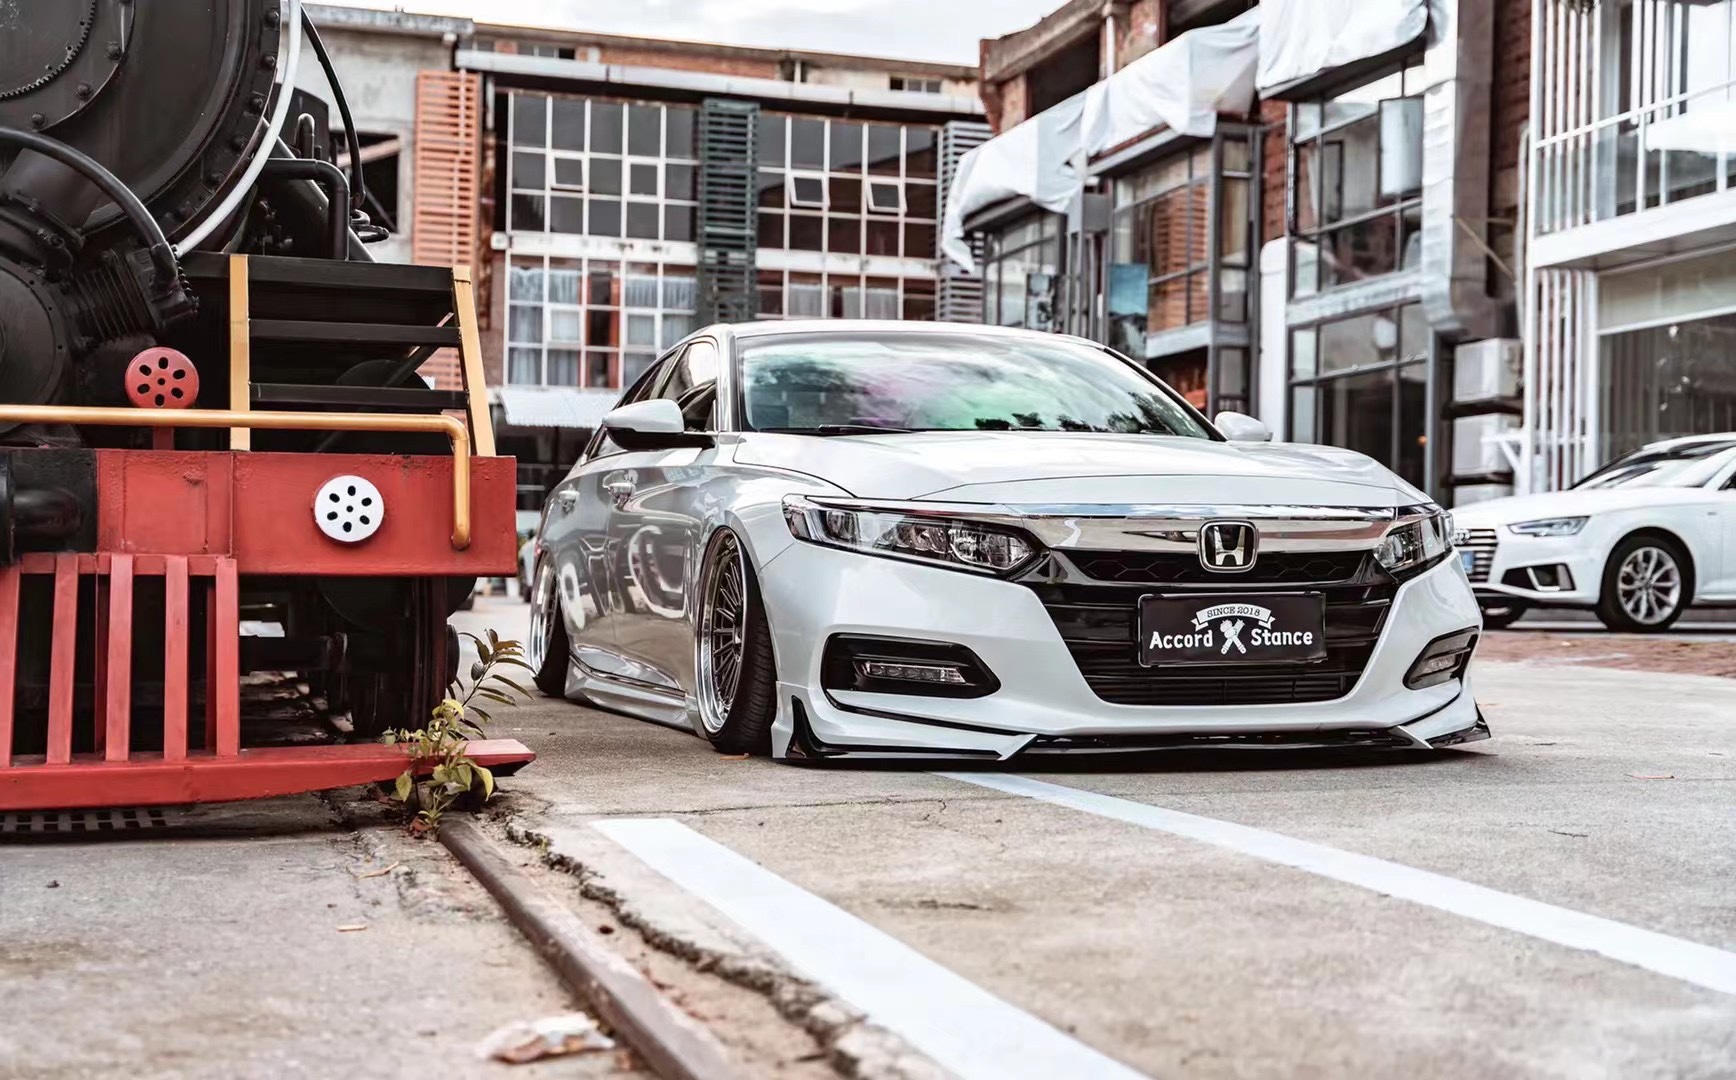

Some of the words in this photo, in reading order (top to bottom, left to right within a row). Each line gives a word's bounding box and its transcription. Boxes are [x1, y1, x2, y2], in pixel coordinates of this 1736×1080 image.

[1206, 606, 1236, 618] SINCE
[1237, 606, 1261, 617] 2018
[1149, 629, 1213, 649] Accord
[1250, 628, 1313, 646] Stance
